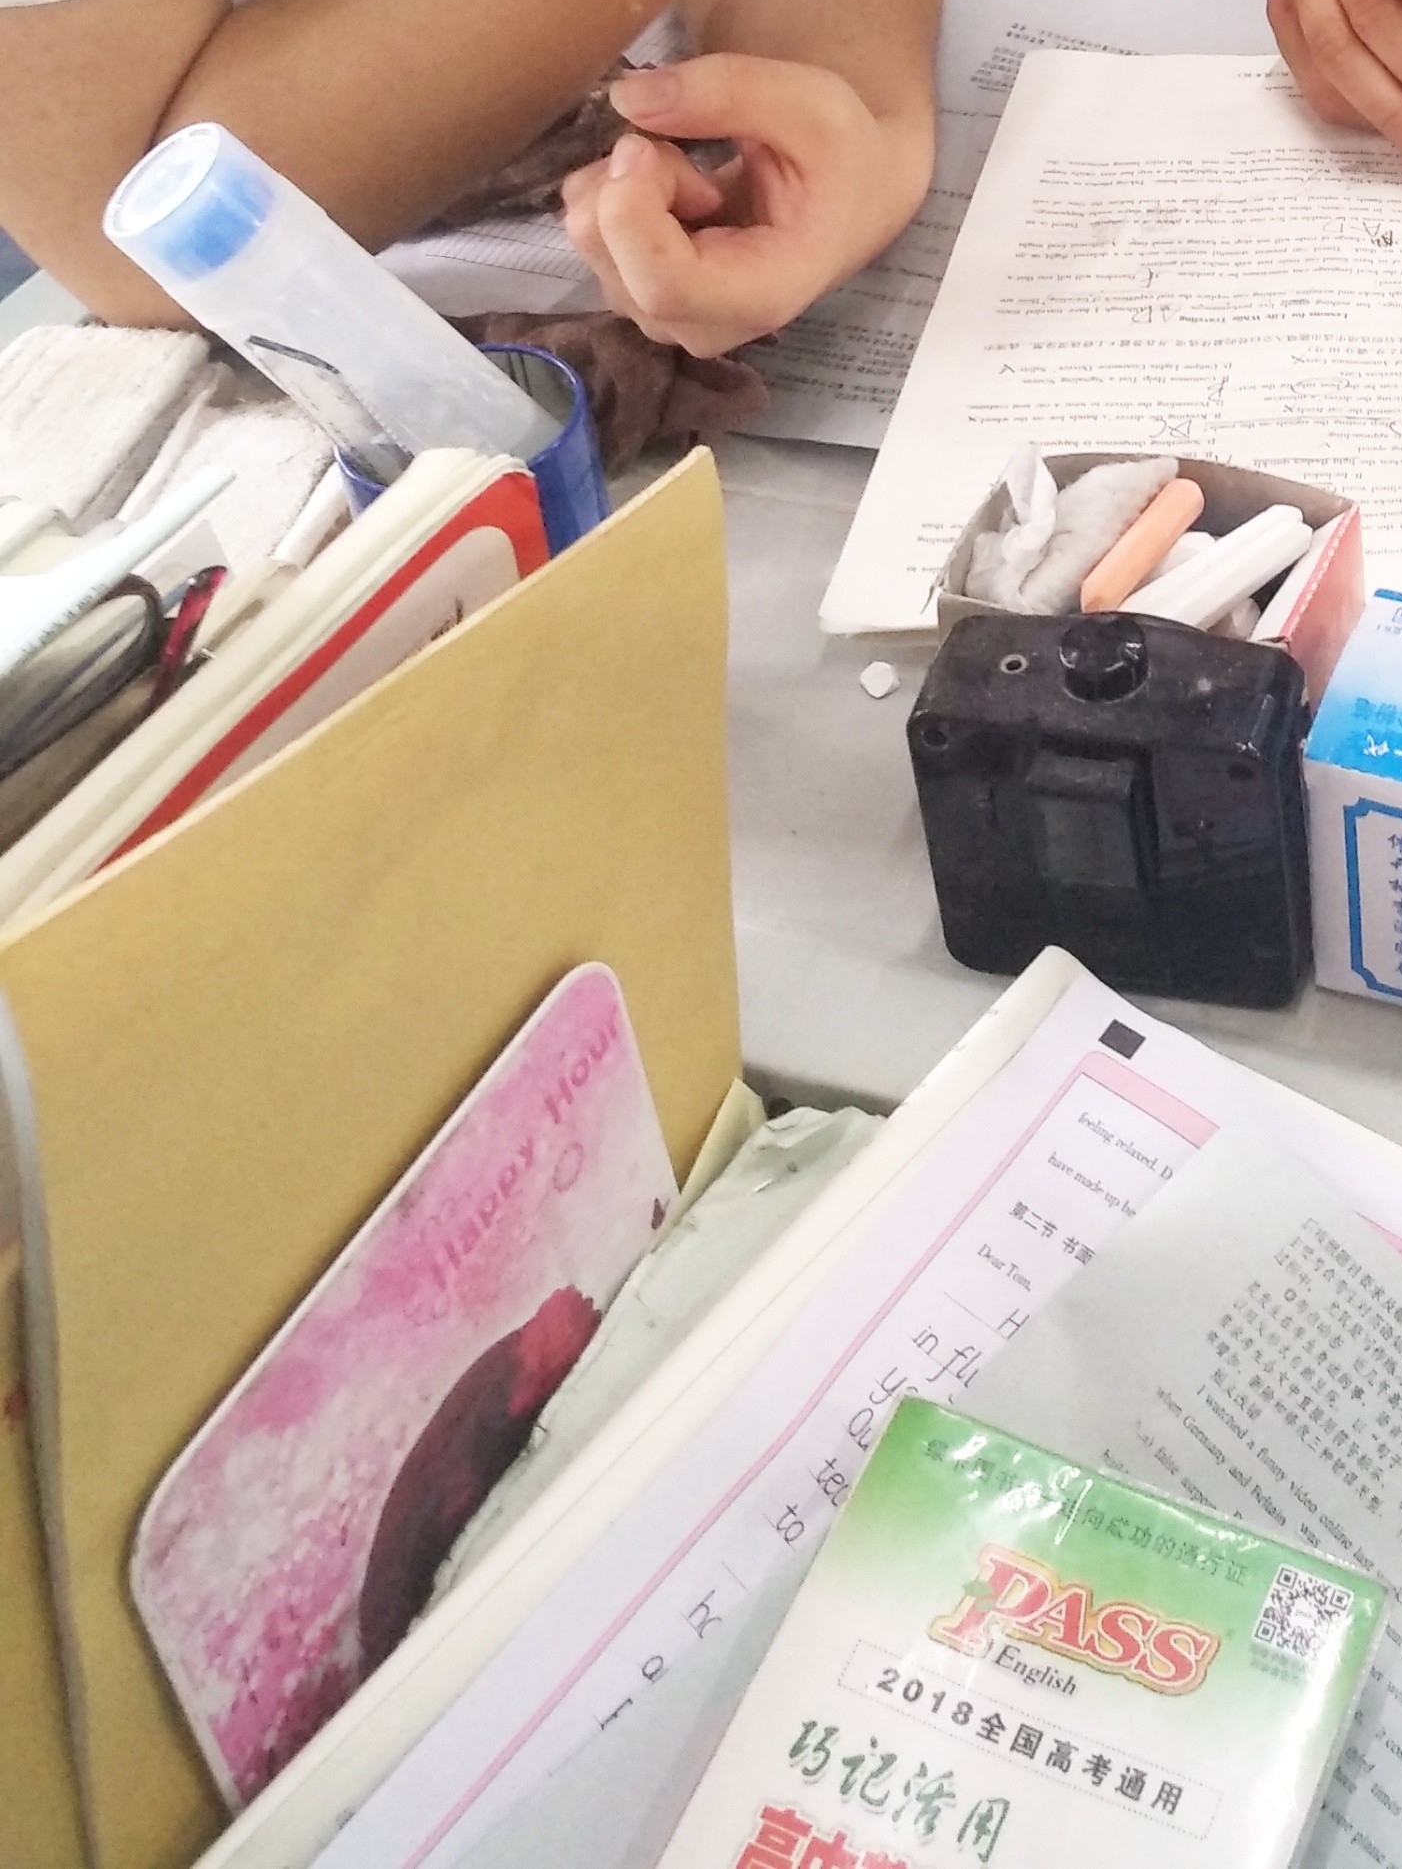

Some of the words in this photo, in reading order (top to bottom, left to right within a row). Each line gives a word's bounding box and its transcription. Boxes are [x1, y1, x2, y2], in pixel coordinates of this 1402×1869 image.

[1007, 1200, 1057, 1241] 第二节
[931, 1548, 1219, 1694] PASS
[998, 1643, 1080, 1699] English
[789, 1720, 1011, 1863] 巧记活用
